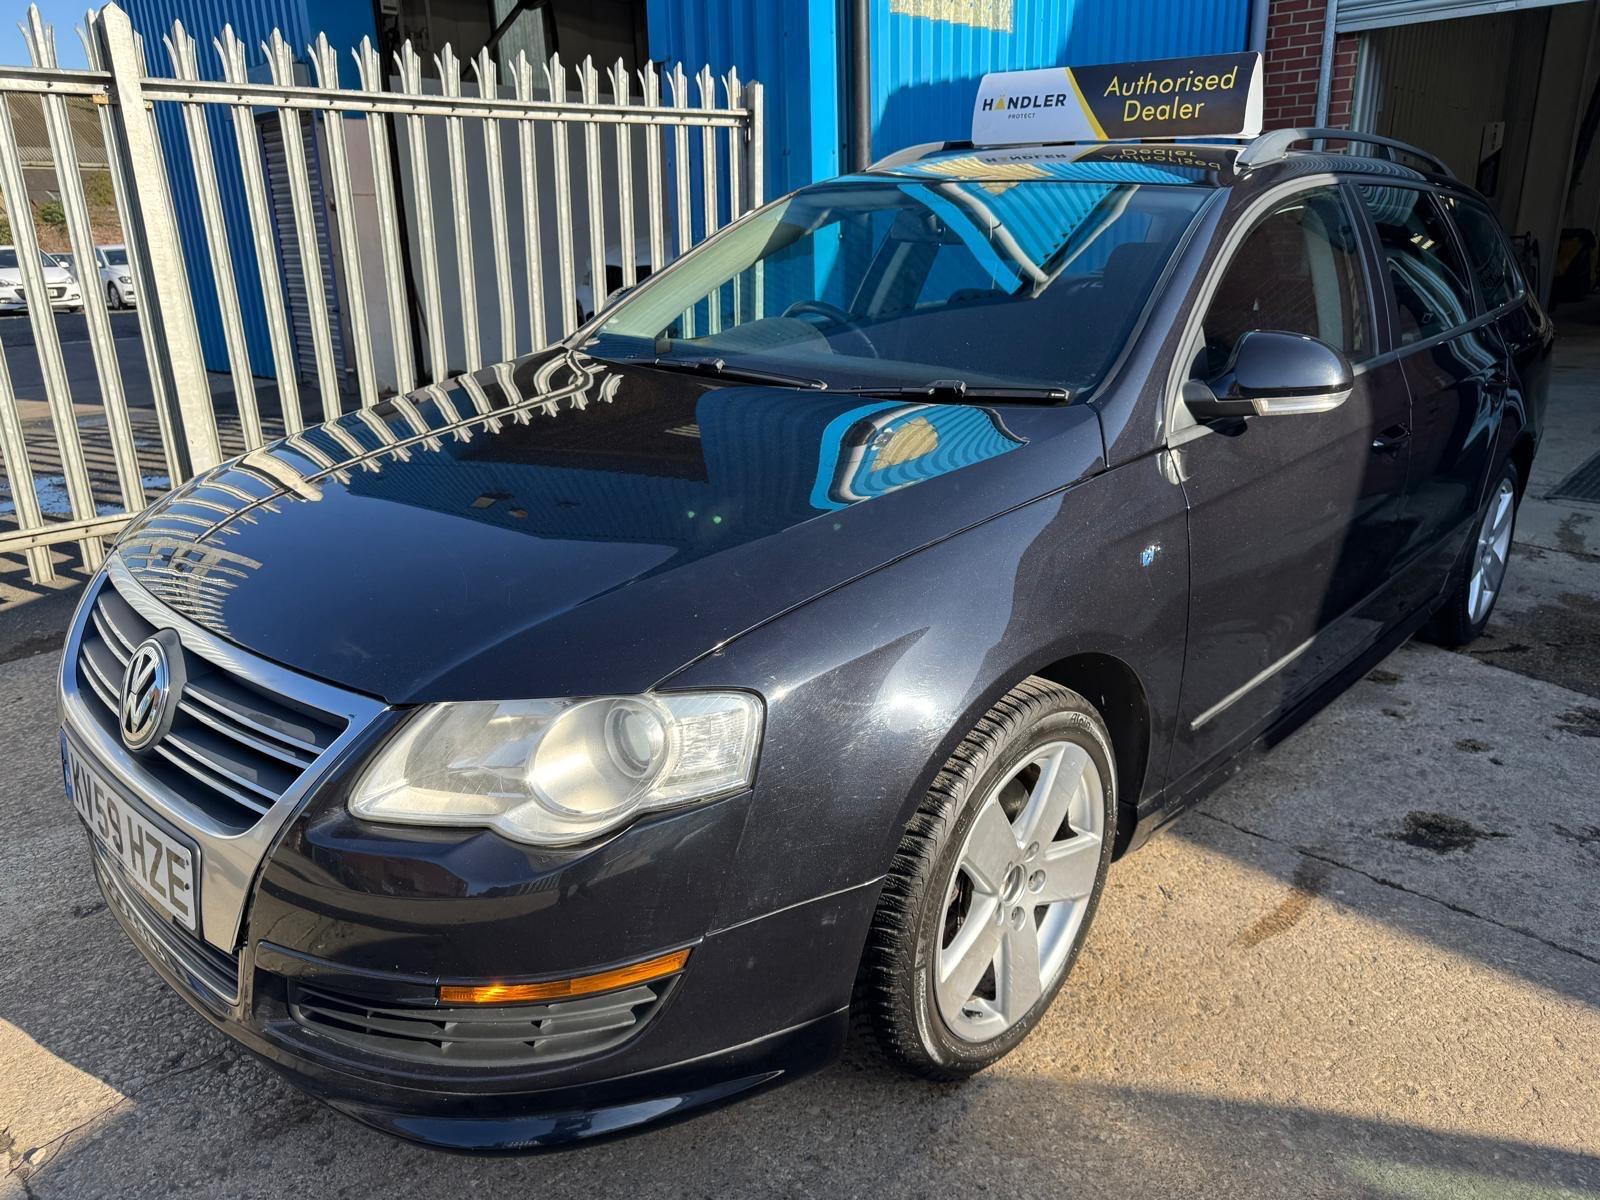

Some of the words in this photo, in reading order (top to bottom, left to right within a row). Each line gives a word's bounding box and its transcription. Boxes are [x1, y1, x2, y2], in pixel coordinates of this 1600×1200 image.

[1104, 66, 1238, 97] Authorised
[1123, 97, 1205, 122] Dealer
[71, 752, 125, 854] KV59
[127, 814, 188, 917] HZE
